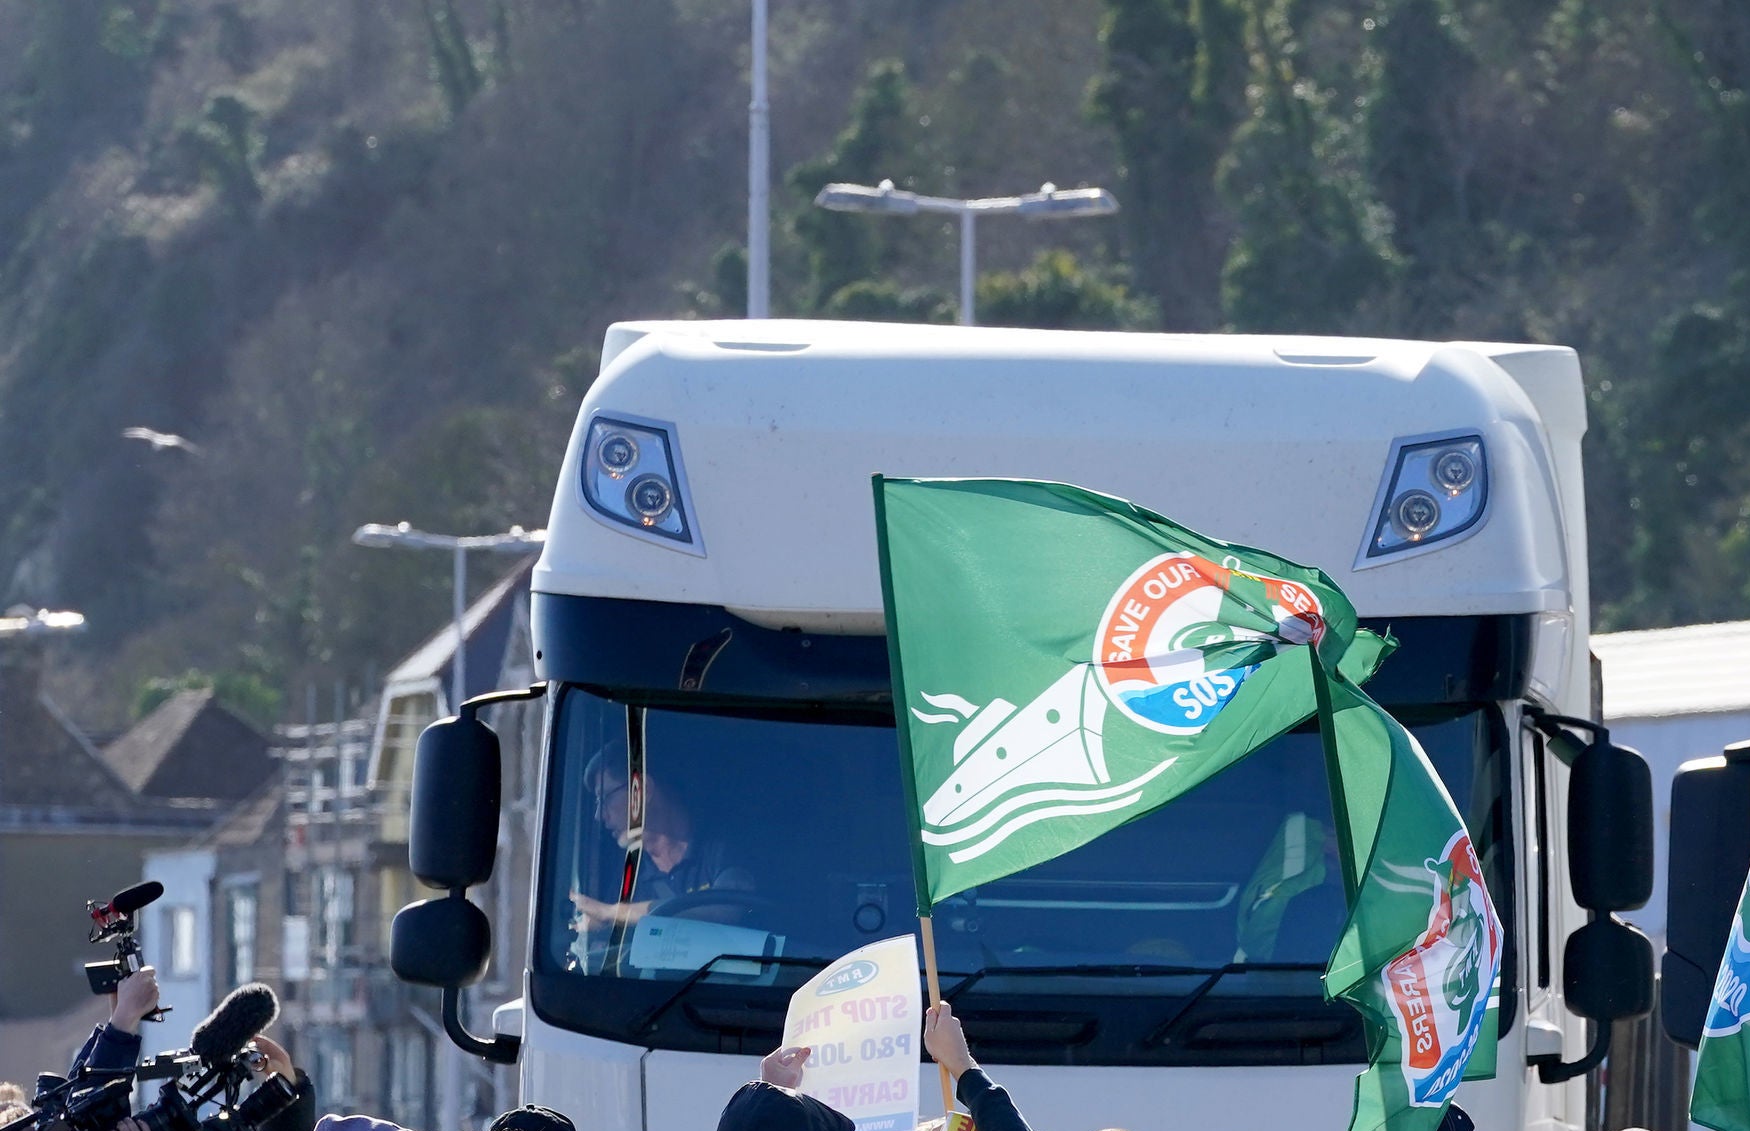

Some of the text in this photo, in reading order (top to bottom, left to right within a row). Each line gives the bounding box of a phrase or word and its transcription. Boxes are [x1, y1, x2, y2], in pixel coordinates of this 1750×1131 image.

[1108, 562, 1202, 663] SAVE OUR
[1173, 673, 1236, 720] SOS
